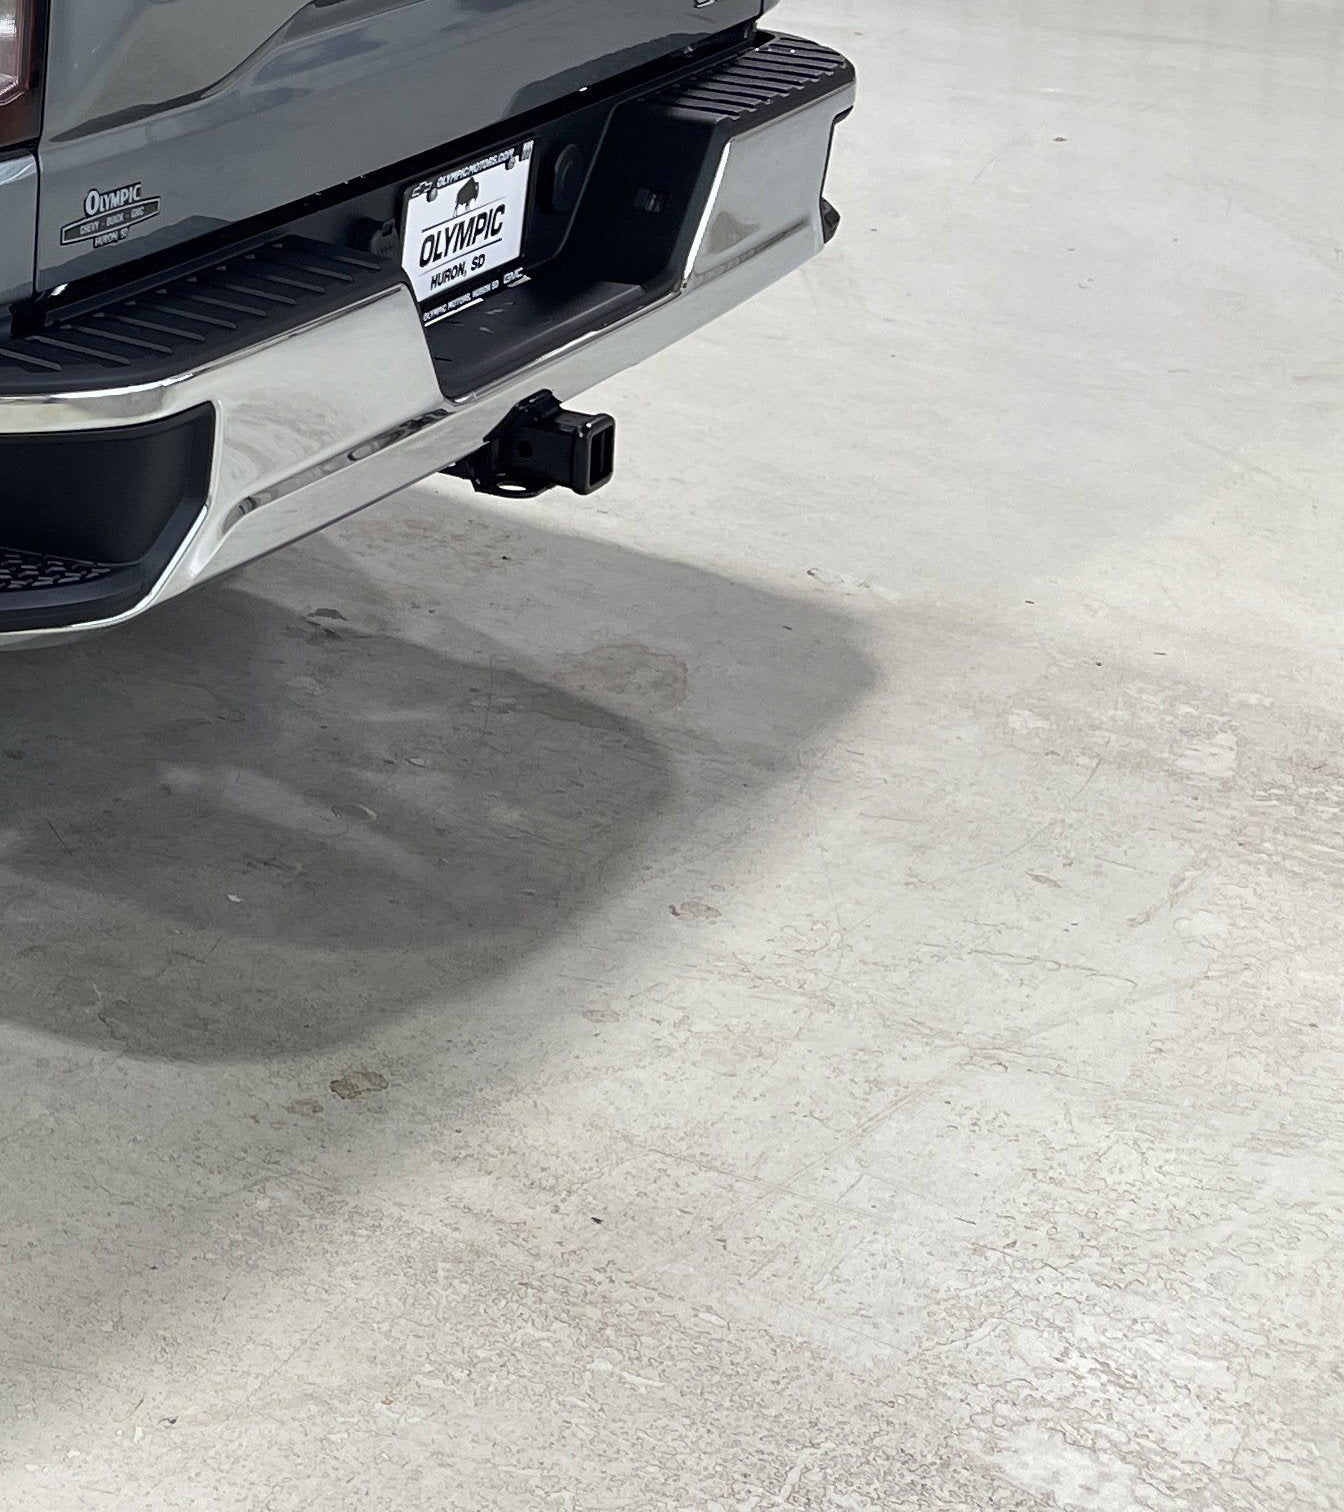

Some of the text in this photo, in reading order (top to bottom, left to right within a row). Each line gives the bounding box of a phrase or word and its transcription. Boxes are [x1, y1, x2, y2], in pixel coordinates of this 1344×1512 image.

[85, 184, 142, 216] OLYMPIC
[419, 203, 506, 268] OLYMPIC
[430, 253, 486, 291] HURON, SD
